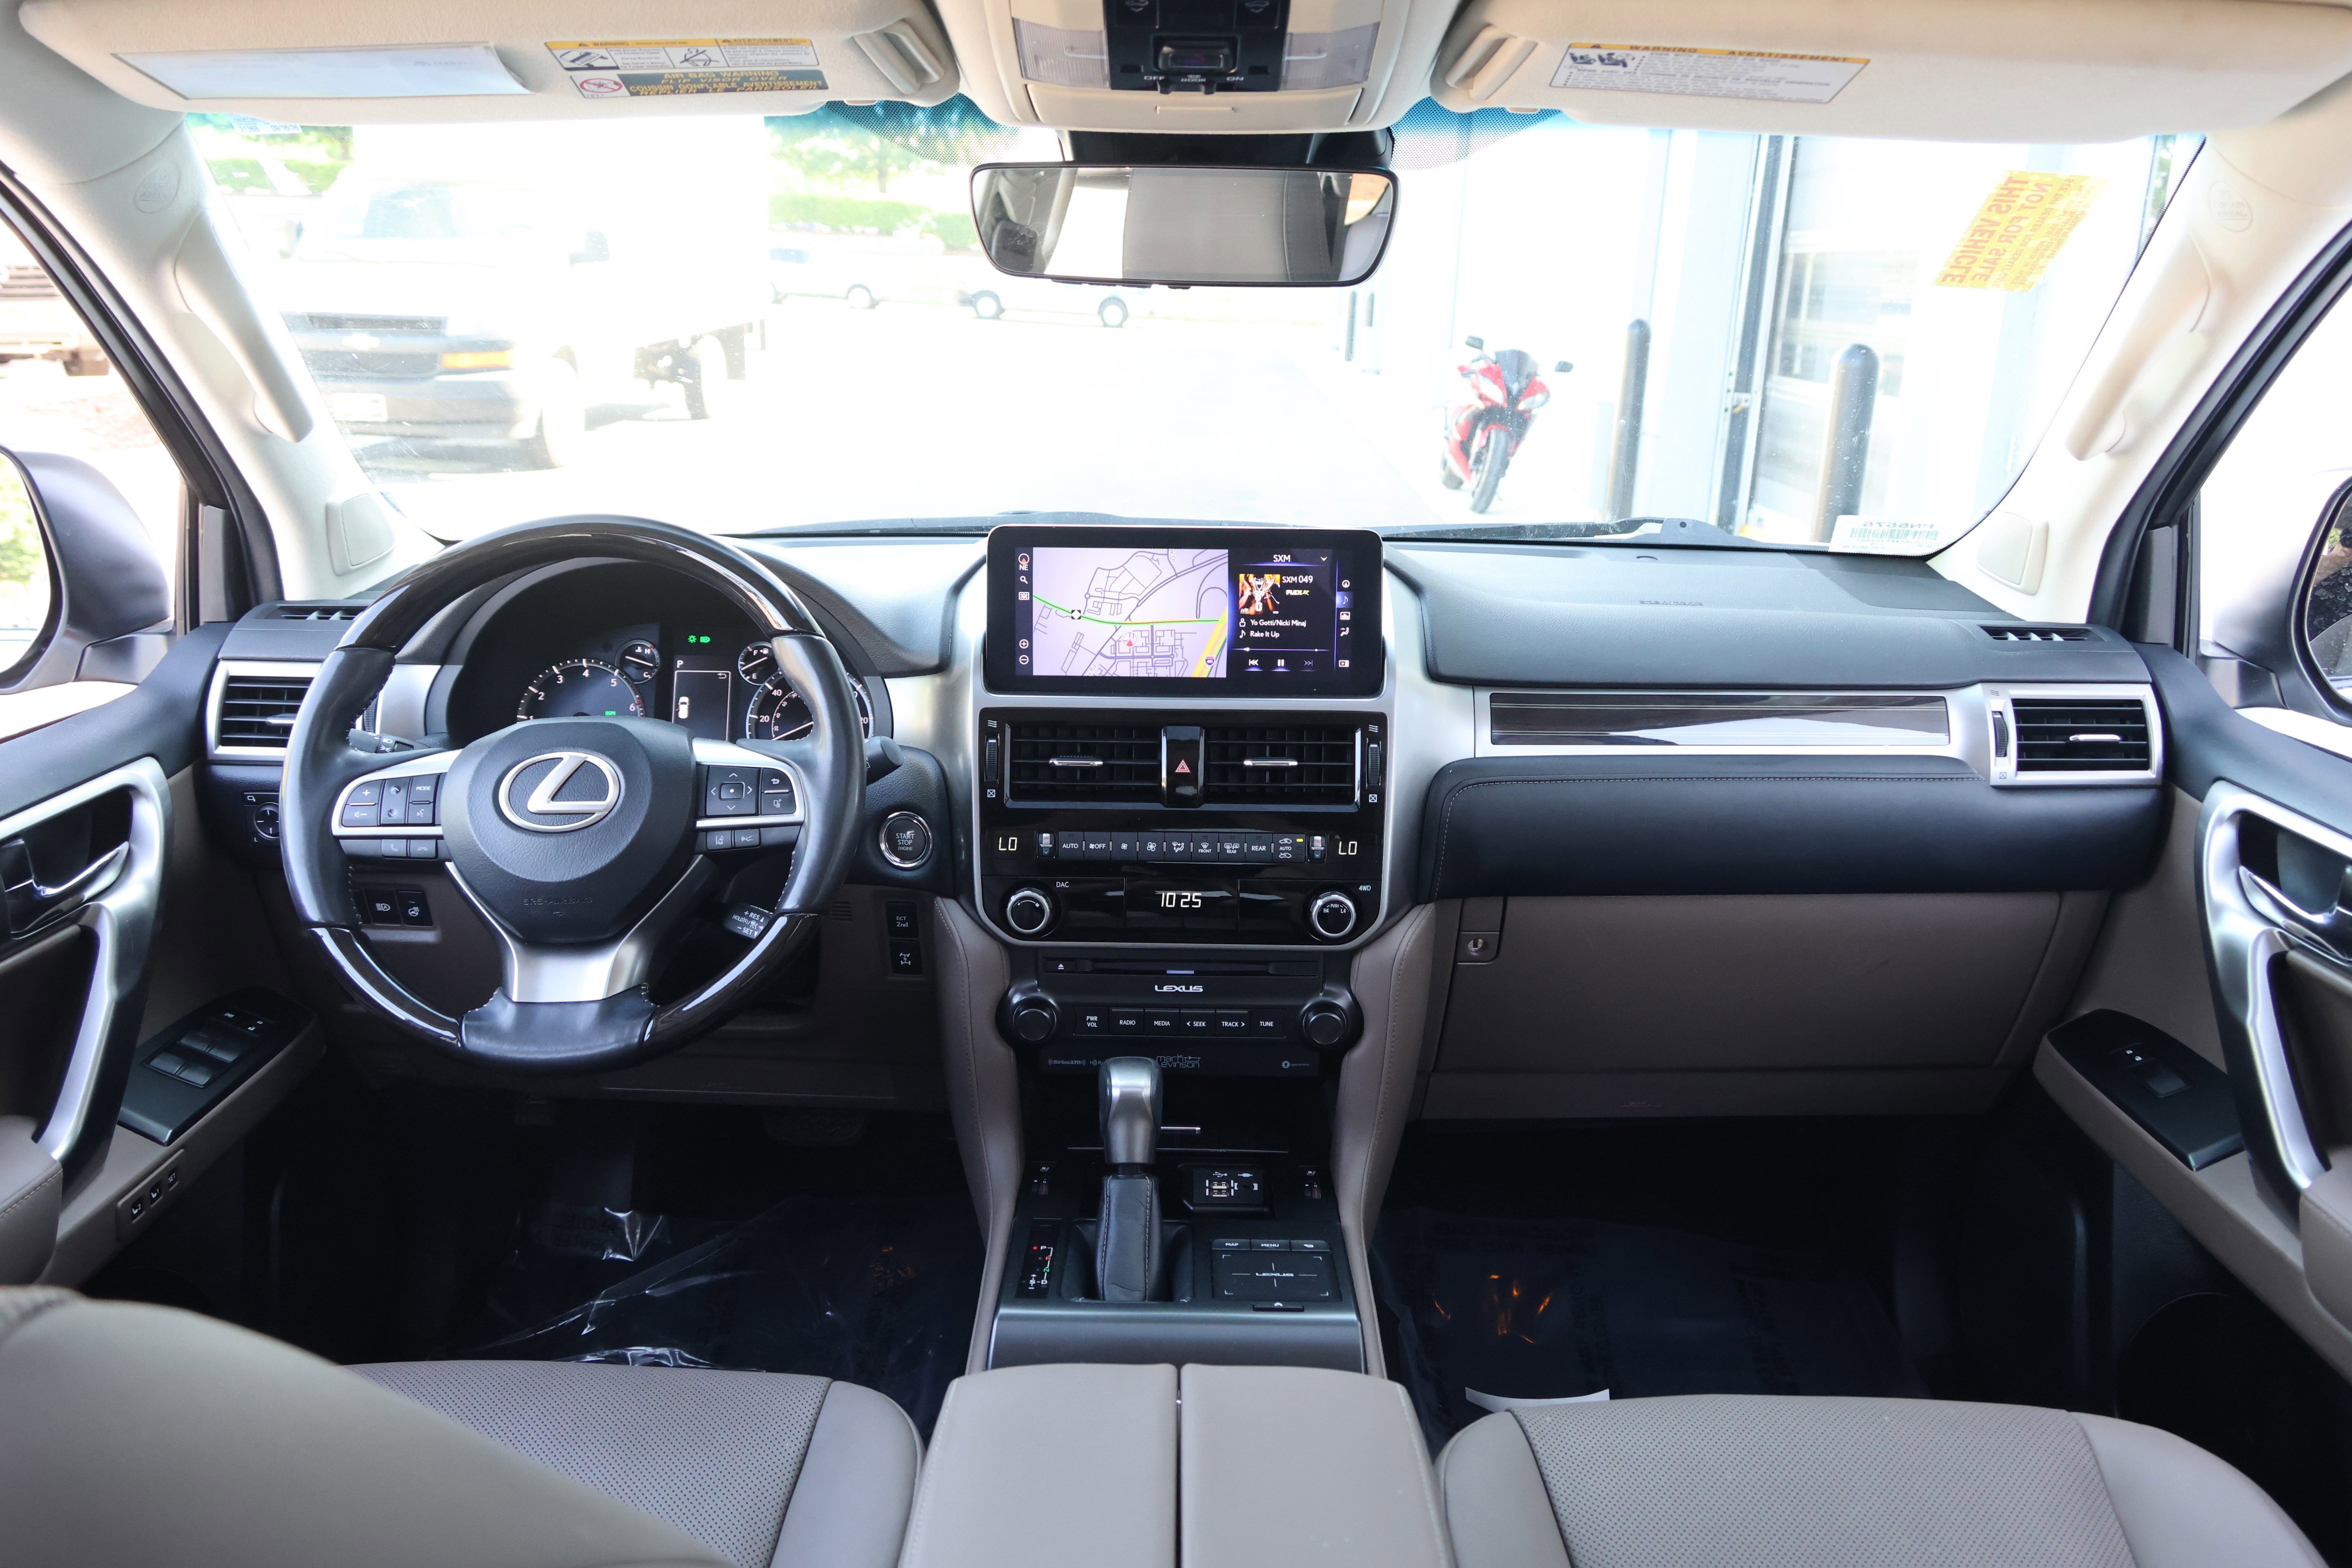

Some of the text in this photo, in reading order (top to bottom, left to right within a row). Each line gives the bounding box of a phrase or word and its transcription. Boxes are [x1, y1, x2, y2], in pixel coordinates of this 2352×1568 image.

[1298, 575, 1313, 584] 049
[582, 669, 590, 677] 4
[557, 675, 564, 684] 3
[610, 678, 617, 687] 5
[629, 703, 635, 711] 6
[998, 837, 1018, 851] LO
[1339, 841, 1358, 855] LO
[742, 927, 753, 935] SET
[168, 1172, 176, 1183] SET
